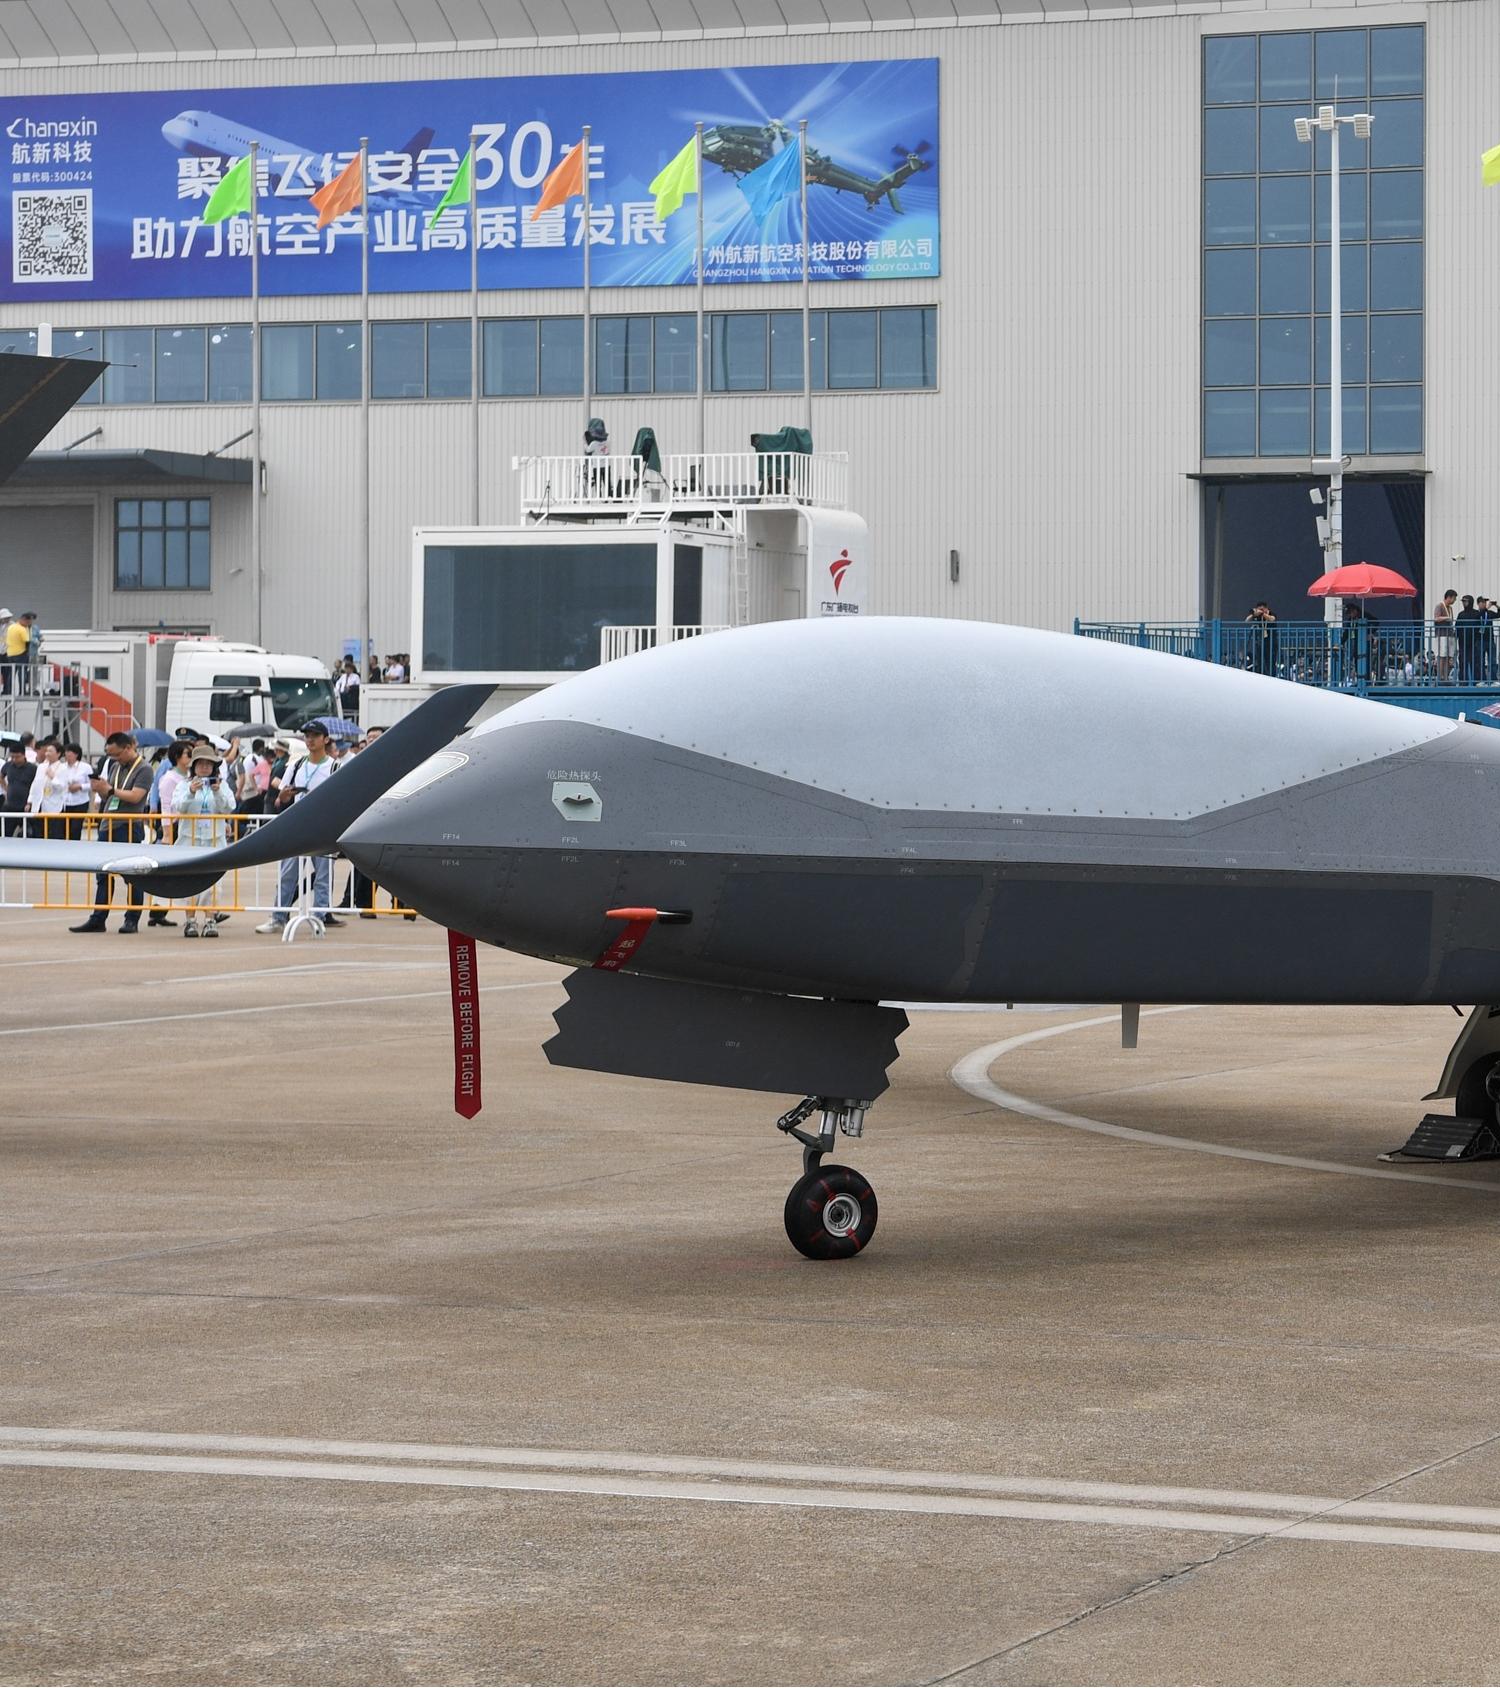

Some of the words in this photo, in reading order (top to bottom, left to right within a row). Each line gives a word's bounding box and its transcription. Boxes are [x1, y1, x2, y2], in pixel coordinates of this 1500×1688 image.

[12, 140, 92, 164] 航新科技
[12, 171, 93, 183] 股票代码:300424
[131, 200, 668, 260] 助力航空产业高质量发展
[692, 238, 933, 265] 广州航新航空科技股份有限公司
[693, 269, 748, 278] GANGZHOU
[750, 267, 791, 276] HANGXIN
[792, 265, 834, 274] AVATION
[836, 263, 896, 274] TECHNOLOGY
[456, 945, 472, 997] REMOVE
[459, 1001, 473, 1049] BEFORE
[461, 1054, 474, 1096] FLIGHT
